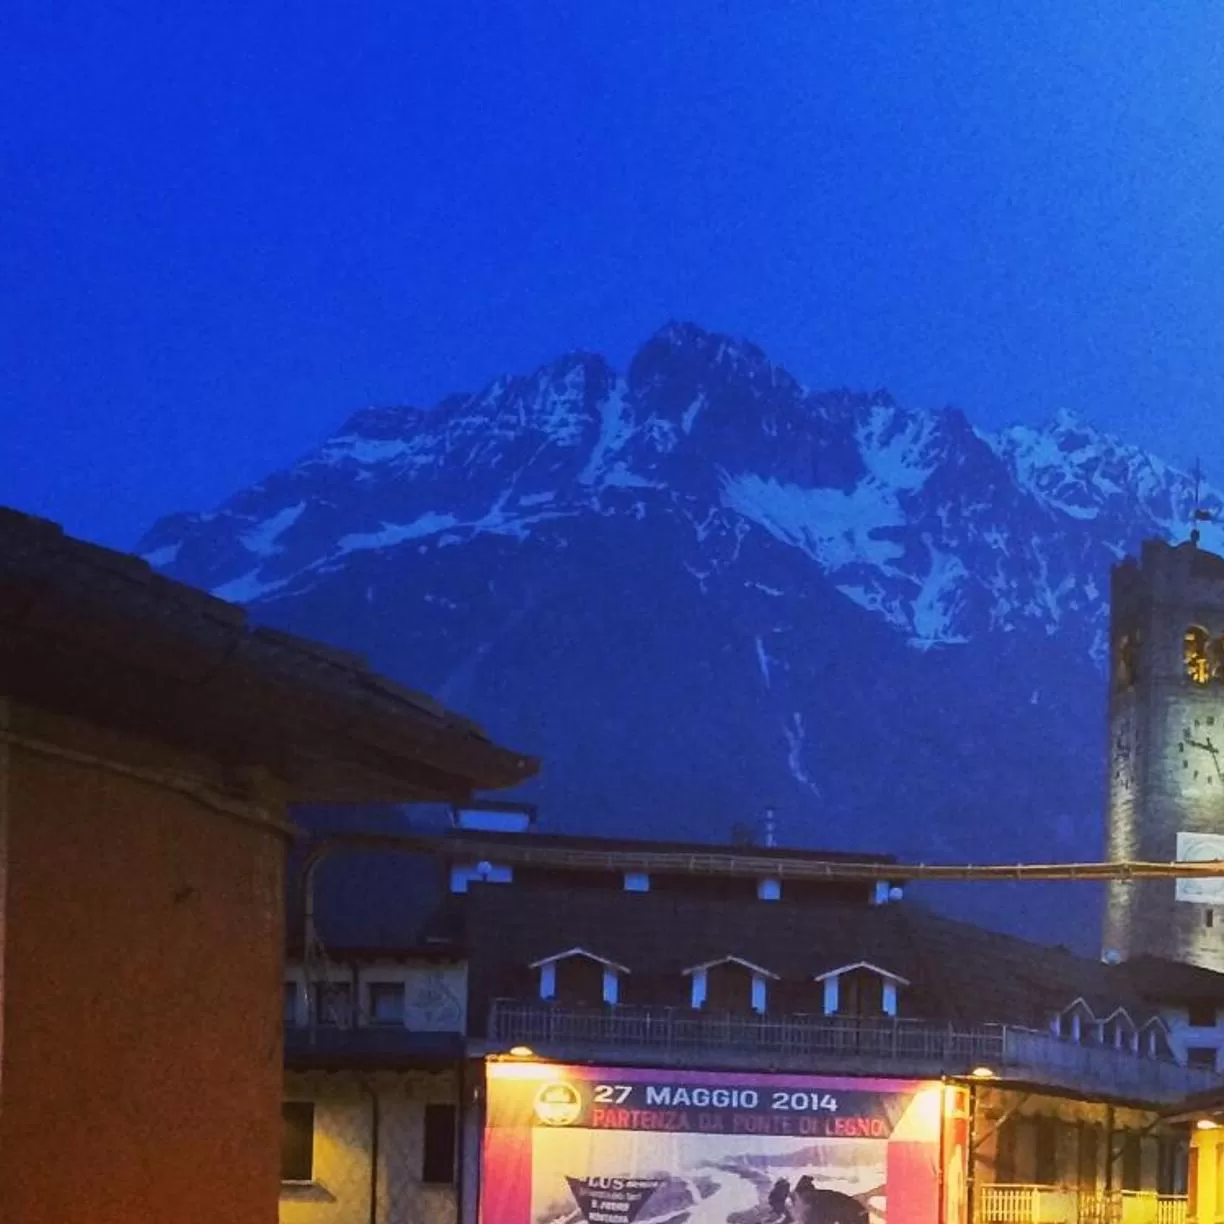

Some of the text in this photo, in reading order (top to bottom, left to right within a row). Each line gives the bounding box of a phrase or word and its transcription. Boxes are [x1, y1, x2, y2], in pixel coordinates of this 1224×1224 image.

[592, 1085, 838, 1112] 27 MAGGIO 2014
[592, 1109, 691, 1131] PARTENZA
[733, 1113, 792, 1134] PONTE
[800, 1115, 818, 1134] DI
[825, 1116, 883, 1137] LEGNO
